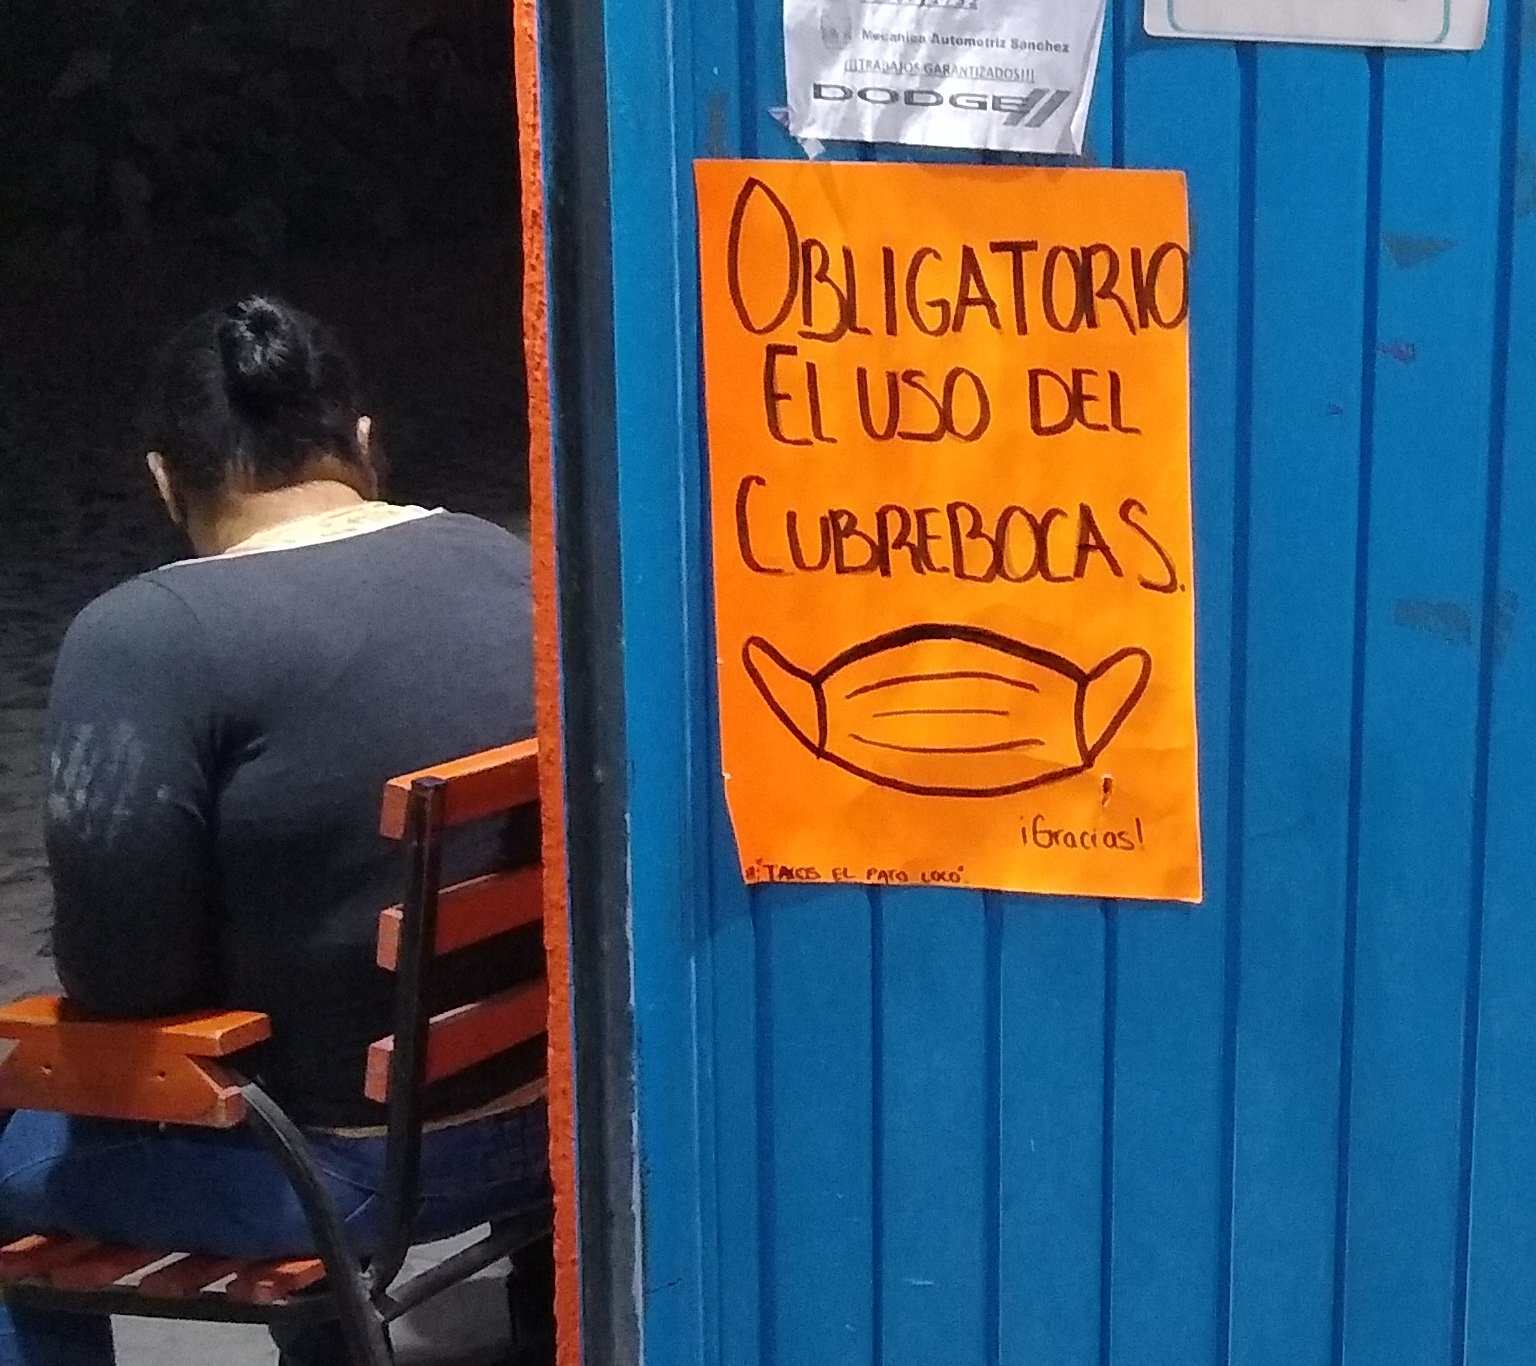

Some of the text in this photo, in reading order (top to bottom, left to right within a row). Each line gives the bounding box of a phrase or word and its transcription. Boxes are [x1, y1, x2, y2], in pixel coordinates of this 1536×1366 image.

[931, 32, 1006, 49] Automotriz
[812, 83, 1033, 115] DODGE
[727, 176, 1191, 342] OBLIGATORIO
[858, 366, 991, 444] USO
[1030, 366, 1142, 439] DEL
[1020, 815, 1146, 852] ¡Gracias!
[831, 866, 856, 881] EL
[866, 867, 909, 885] PATO
